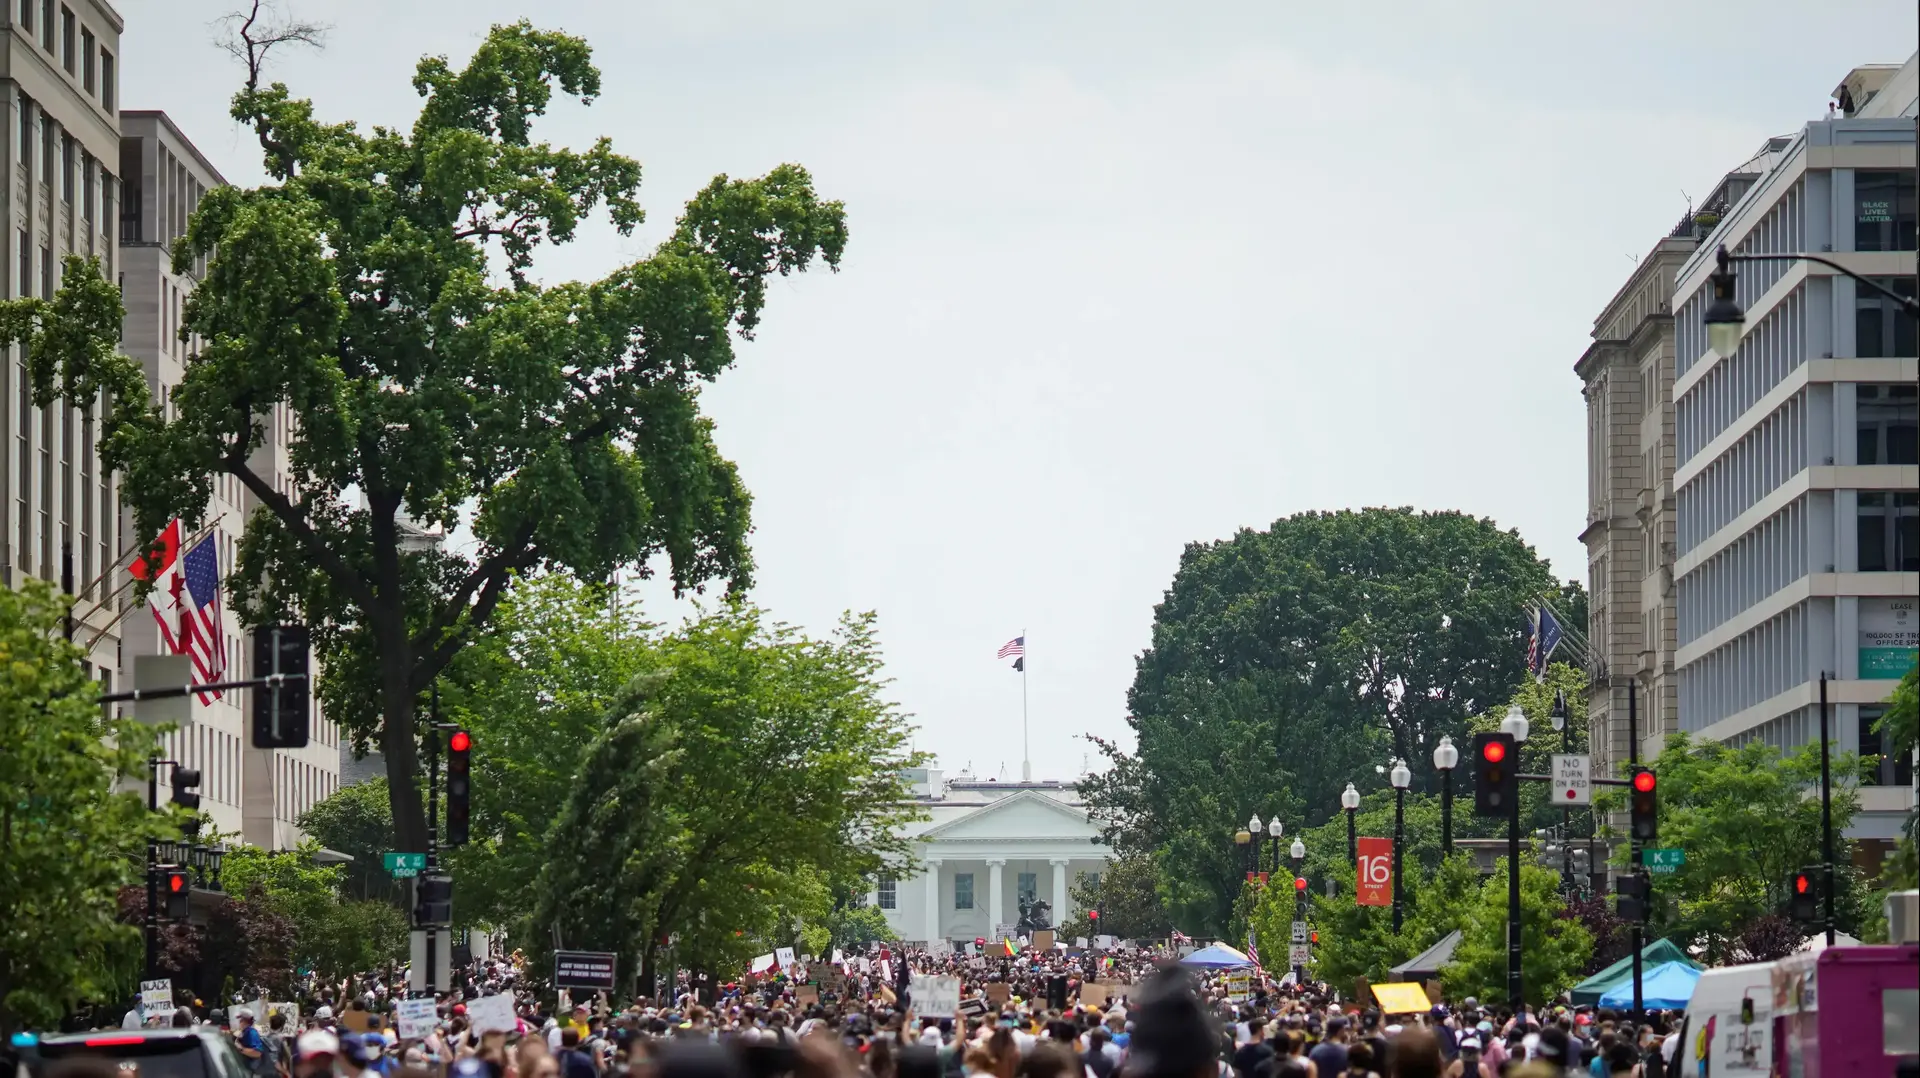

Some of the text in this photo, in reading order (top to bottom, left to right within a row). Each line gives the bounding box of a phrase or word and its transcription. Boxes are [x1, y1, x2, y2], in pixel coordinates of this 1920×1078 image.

[1563, 758, 1580, 768] NO
[1560, 770, 1583, 778] TURN
[1555, 780, 1587, 788] ON RED
[396, 856, 406, 868] K
[1653, 852, 1664, 864] K
[394, 868, 418, 877] 1500
[1358, 855, 1390, 883] 16
[1651, 864, 1676, 873] 1600
[143, 980, 169, 991] BLACK
[143, 1000, 172, 1011] MATTER
